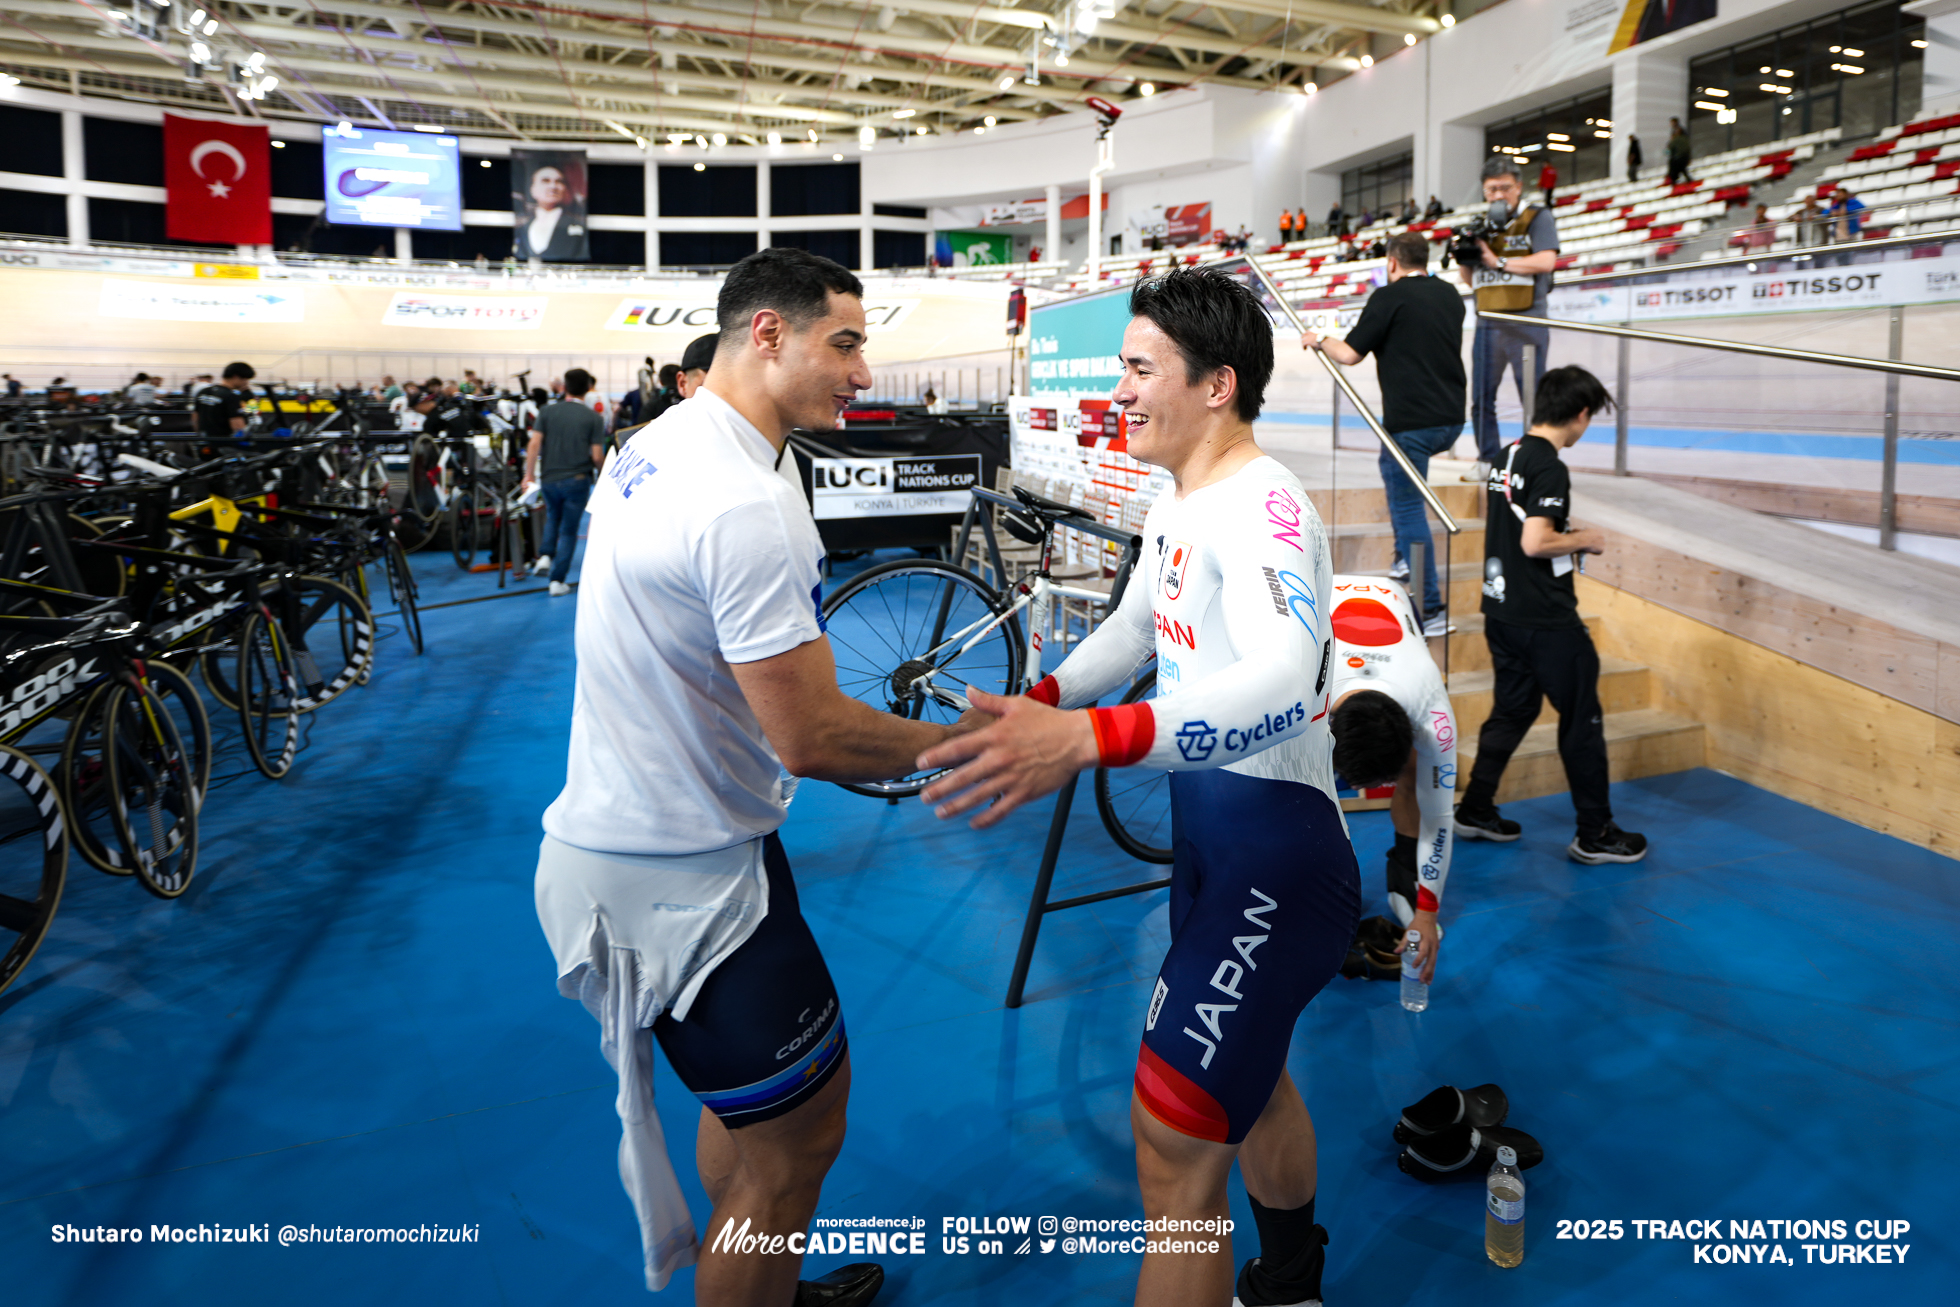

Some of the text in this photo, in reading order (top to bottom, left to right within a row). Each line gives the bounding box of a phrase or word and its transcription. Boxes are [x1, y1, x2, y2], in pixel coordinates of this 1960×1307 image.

[3, 254, 39, 266] UCI
[1664, 285, 1737, 305] TISSOT
[1787, 274, 1882, 295] TISSOT
[829, 462, 936, 488] UCI TRACK
[898, 473, 975, 488] NATIONS CUP
[854, 500, 894, 511] KONYA
[1261, 566, 1290, 618] KEIRIN
[1224, 701, 1305, 752] Cyclers
[1429, 827, 1448, 865] Cyclers
[1183, 887, 1278, 1070] JAPAN
[775, 998, 835, 1061] CORIMA
